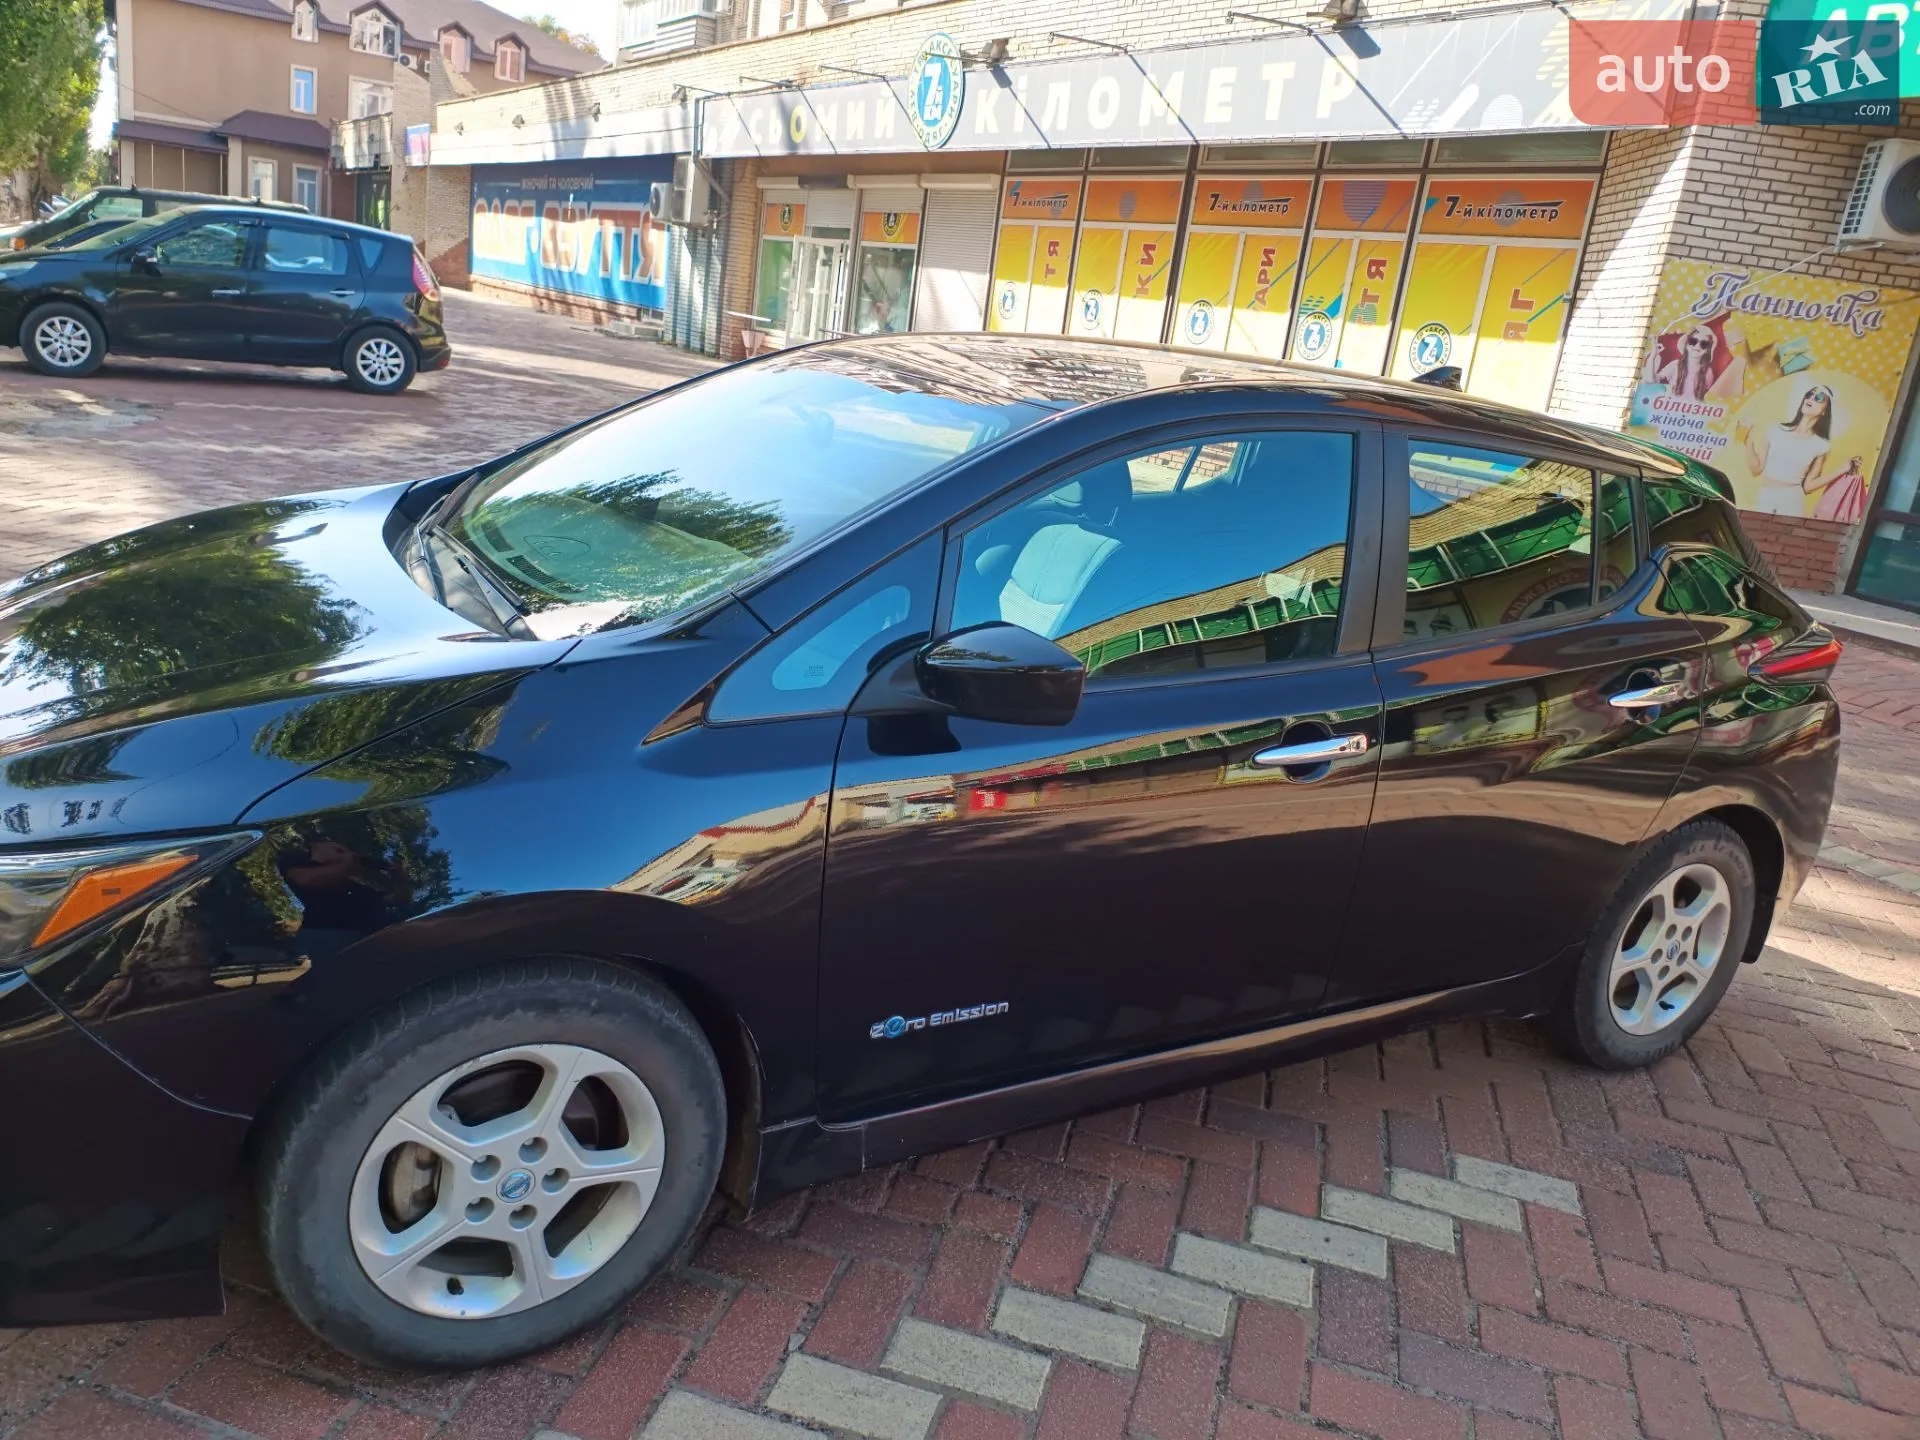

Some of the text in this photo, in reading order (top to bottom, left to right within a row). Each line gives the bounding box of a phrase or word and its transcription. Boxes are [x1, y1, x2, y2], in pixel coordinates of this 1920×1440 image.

[1800, 1, 1920, 64] АВ
[1232, 200, 1289, 215] кілометр
[1445, 195, 1559, 222] 7-й кілометр
[1692, 272, 1883, 336] Панночка
[1653, 395, 1724, 418] білизна
[1649, 413, 1704, 430] жіноча
[1660, 430, 1728, 447] чоловіча
[929, 1001, 1010, 1027] Emission
